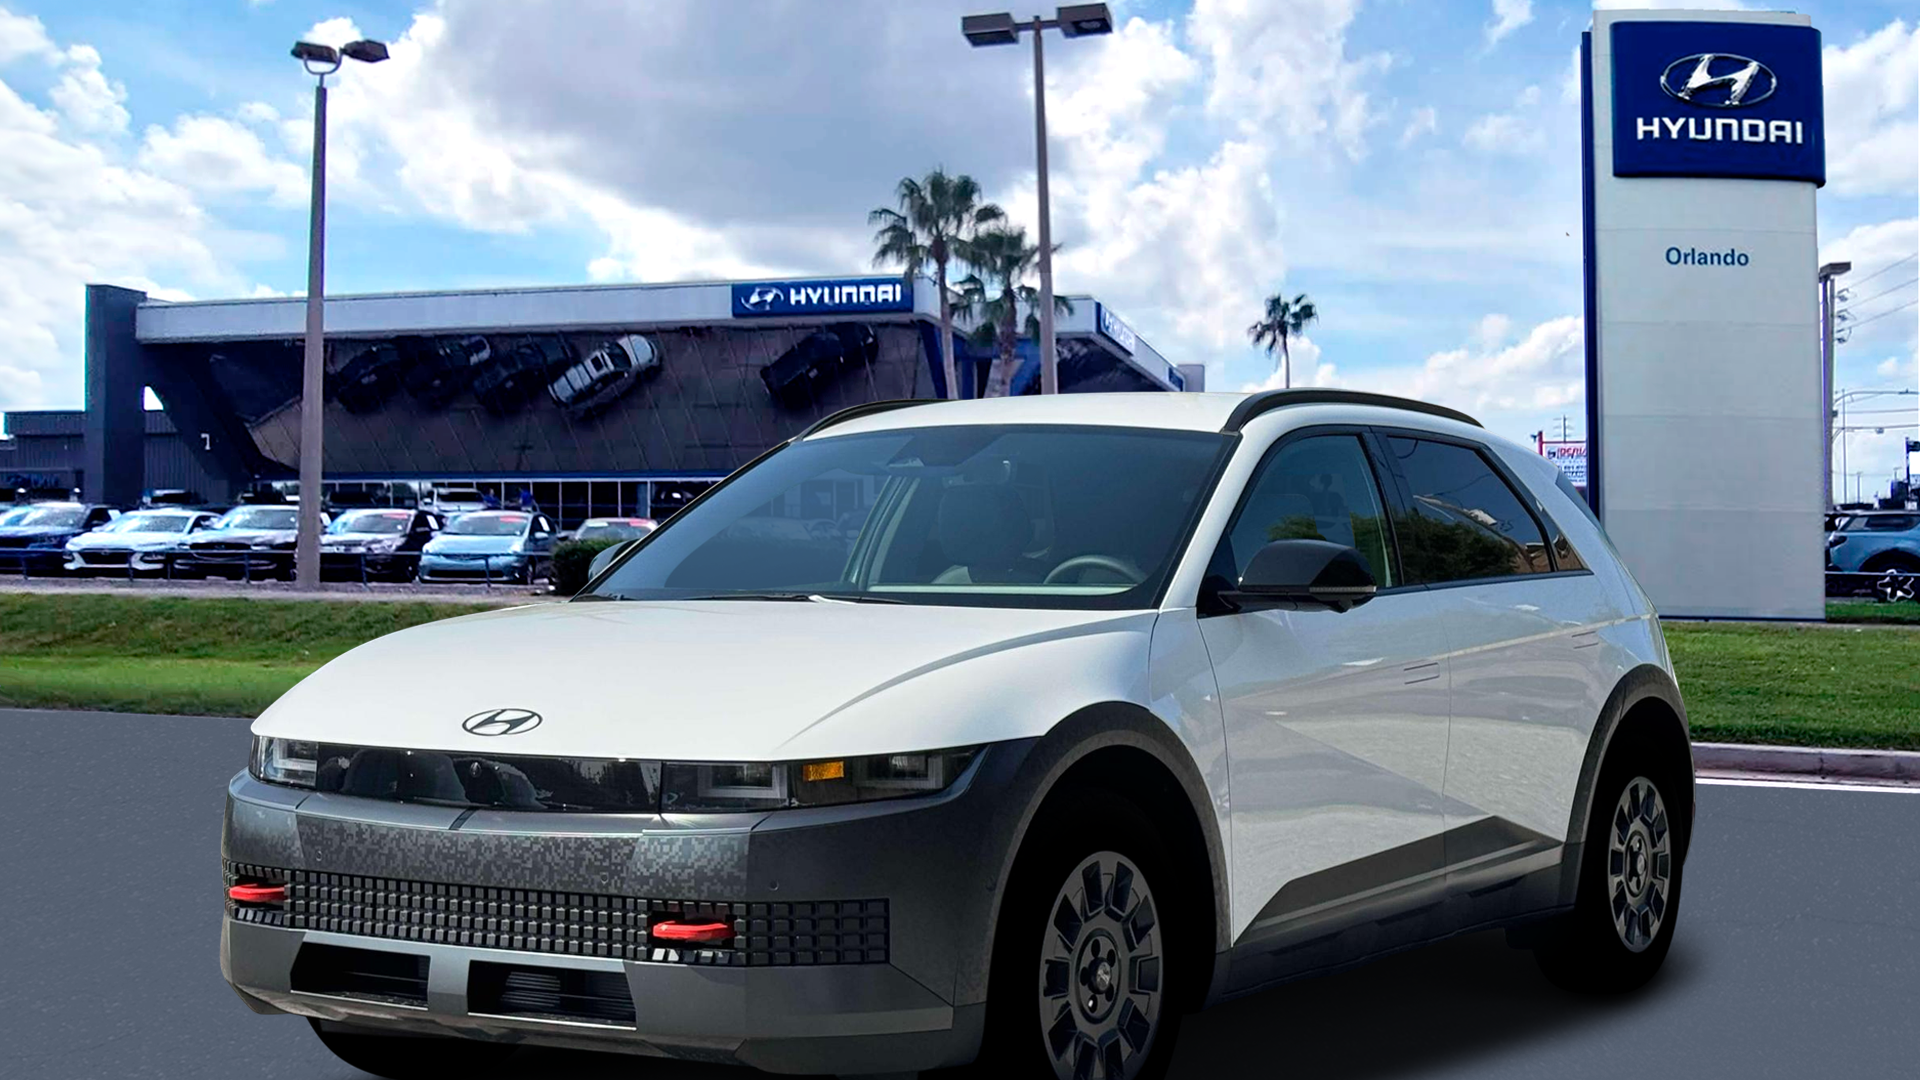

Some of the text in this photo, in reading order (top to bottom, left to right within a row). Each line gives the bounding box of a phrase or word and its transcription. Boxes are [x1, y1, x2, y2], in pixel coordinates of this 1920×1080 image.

[1637, 117, 1803, 144] HYUNDAI
[1666, 247, 1749, 266] Orlando
[790, 284, 901, 306] HYUNDAI
